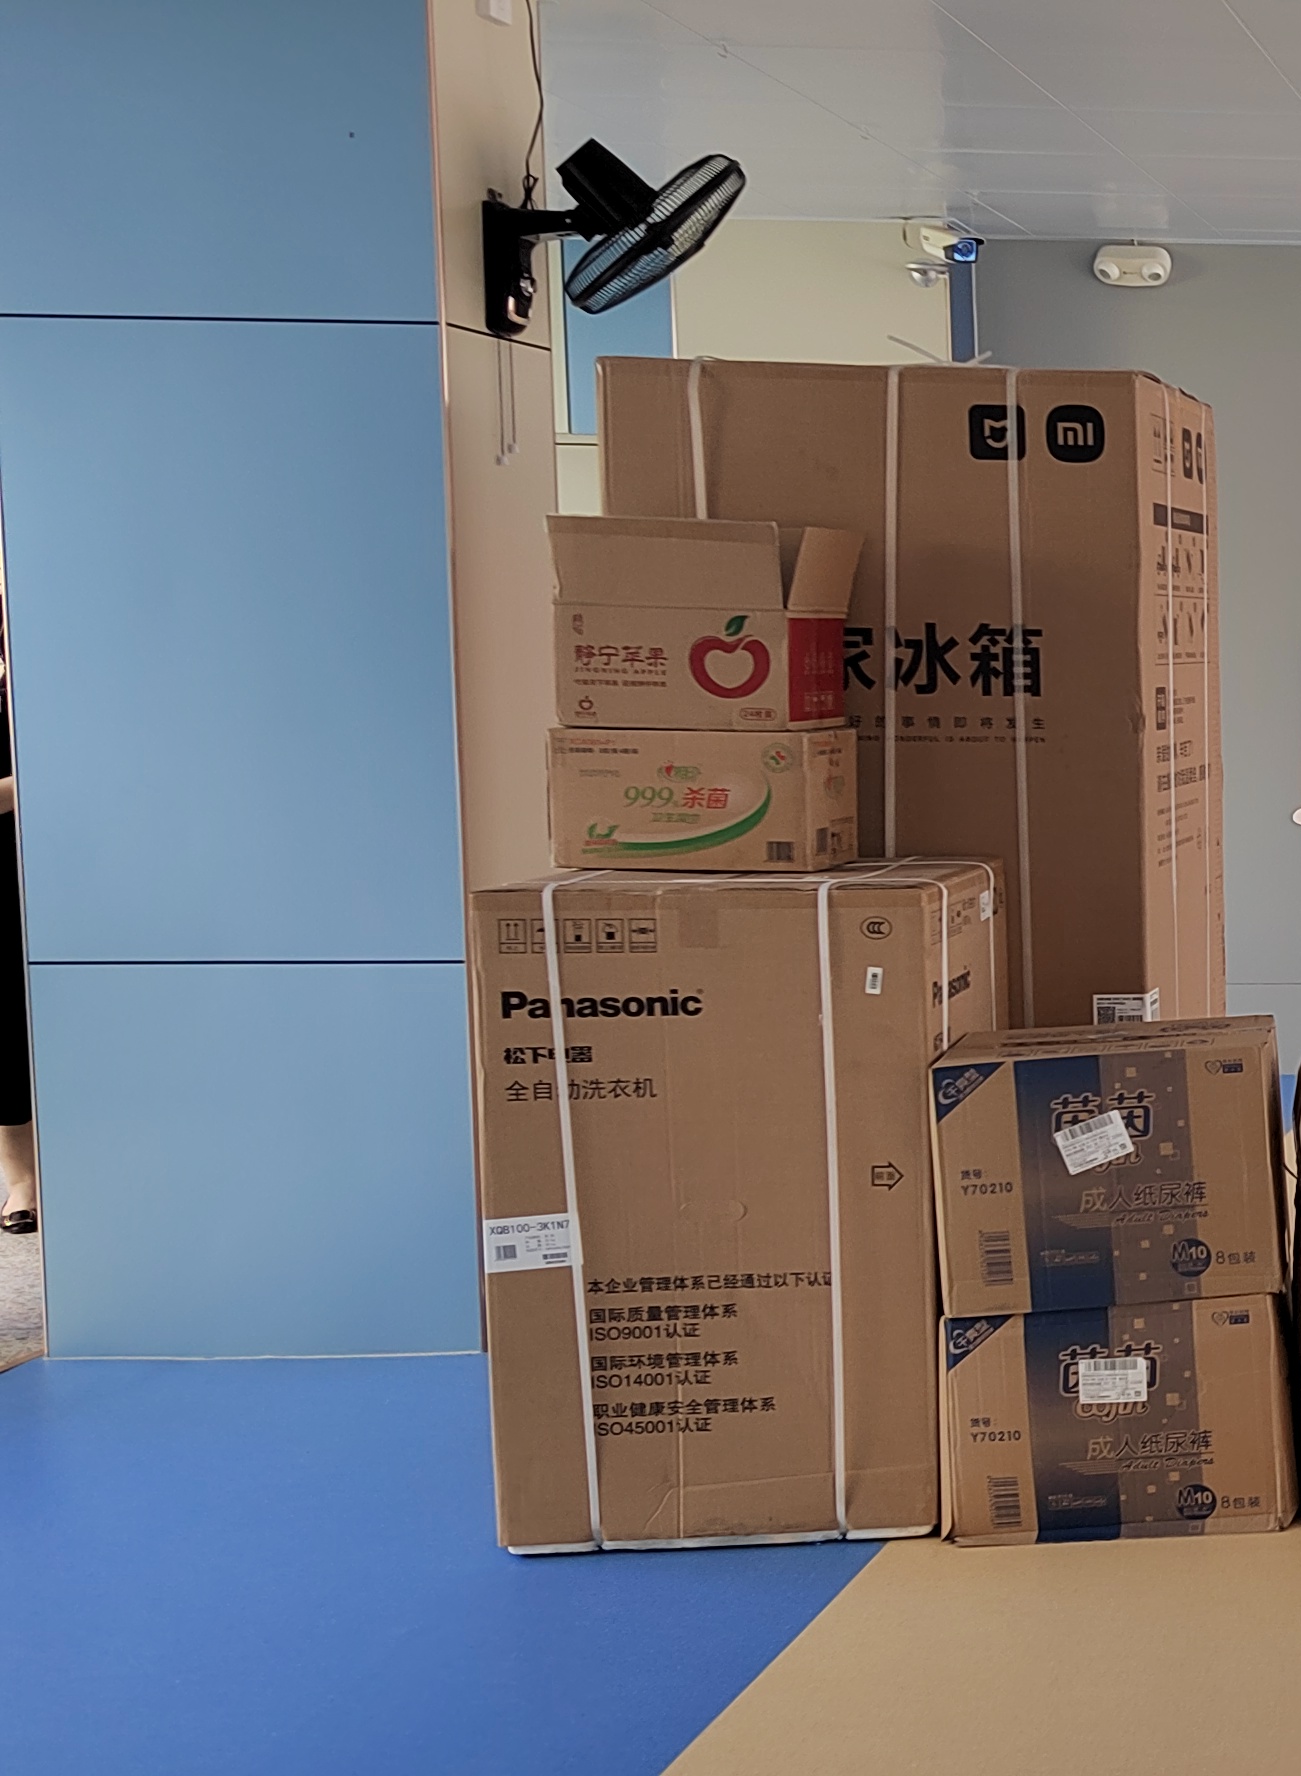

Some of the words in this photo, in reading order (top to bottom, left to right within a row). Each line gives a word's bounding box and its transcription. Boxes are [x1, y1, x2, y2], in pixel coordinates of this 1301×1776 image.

[500, 988, 703, 1019] Panasonic
[961, 1182, 1013, 1196] Y70210
[1079, 1181, 1207, 1213] 成人纸尿裤
[589, 1303, 738, 1324] 国际质量管理体系
[589, 1322, 700, 1341] ISO9001认证
[591, 1350, 739, 1372] 国际环境管理体系
[591, 1370, 712, 1389] ISO14001认证
[593, 1396, 776, 1419] 职业健康安全管理体系
[970, 1430, 1021, 1443] Y70210
[1087, 1430, 1213, 1461] 成人纸尿裤
